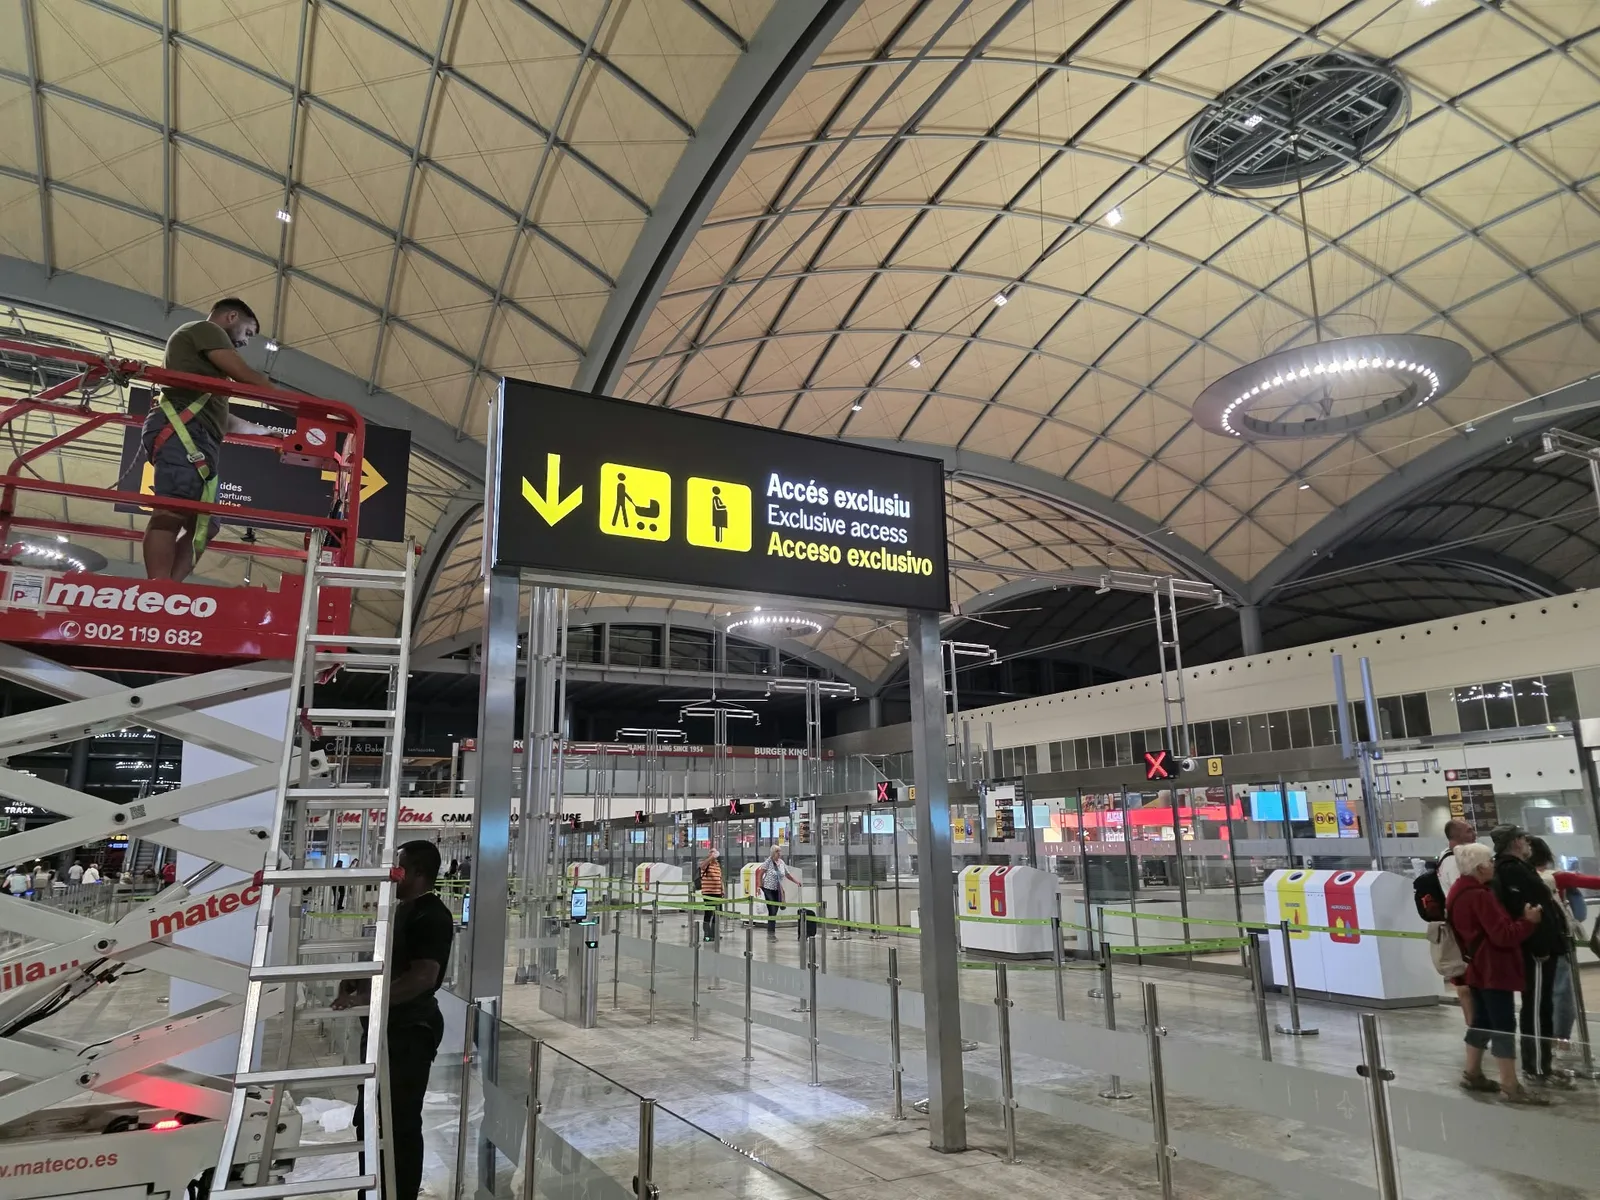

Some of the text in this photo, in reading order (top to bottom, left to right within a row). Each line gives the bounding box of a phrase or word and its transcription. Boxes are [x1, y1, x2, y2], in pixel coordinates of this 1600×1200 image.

[219, 491, 252, 502] partures
[766, 473, 911, 518] Accés exclusiu
[768, 504, 908, 544] Exclusive access
[767, 531, 933, 576] Acceso exclusivo
[46, 582, 218, 618] mateco
[84, 623, 203, 646] 902 119 682
[754, 747, 808, 757] BURGER KING
[1212, 761, 1218, 772] 9
[4, 806, 34, 814] TRACK
[0, 959, 79, 993] ila...
